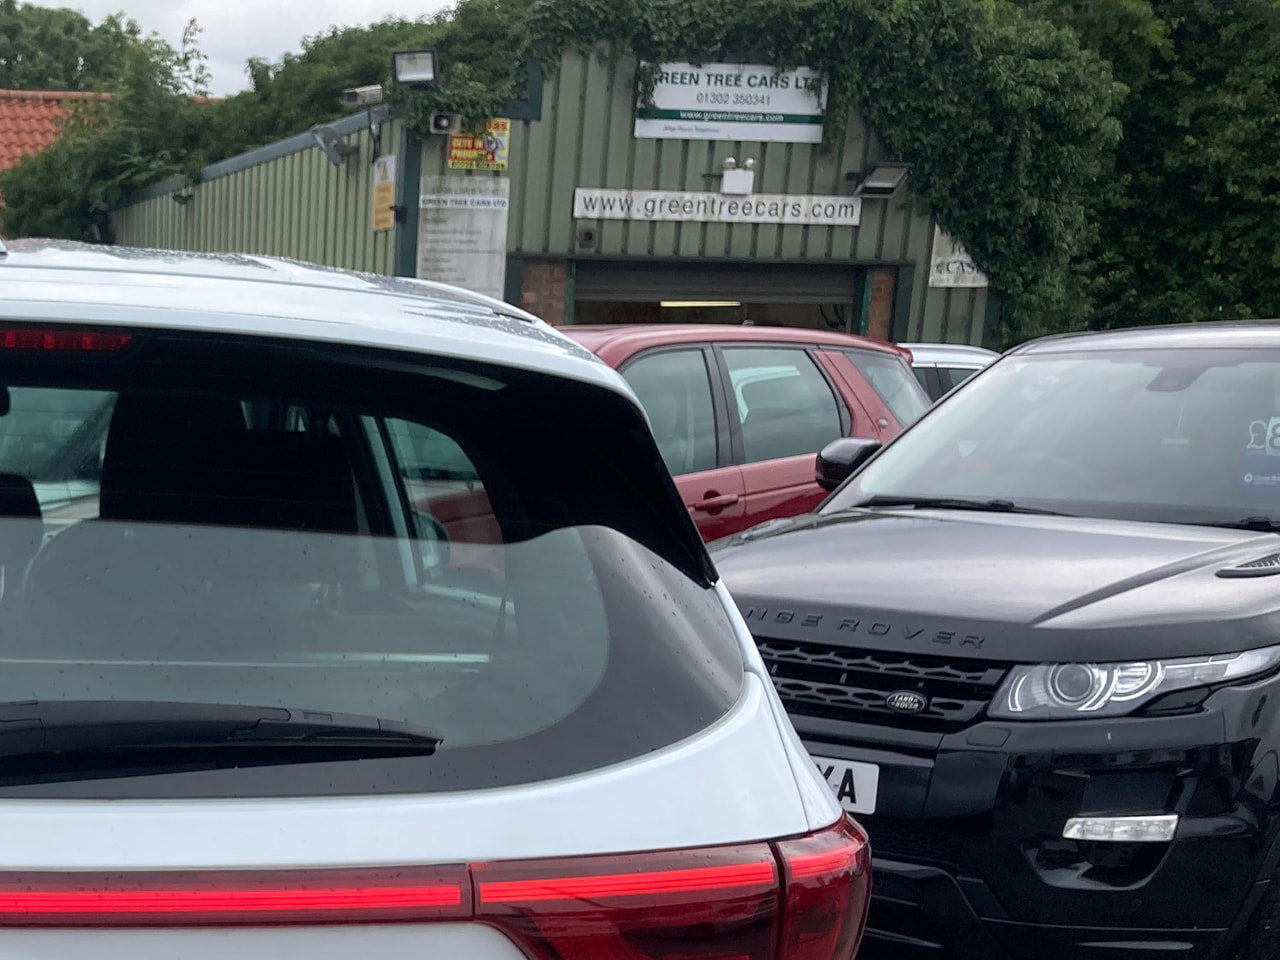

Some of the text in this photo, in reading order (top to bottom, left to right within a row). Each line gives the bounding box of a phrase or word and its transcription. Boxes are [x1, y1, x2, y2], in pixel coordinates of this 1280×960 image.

[705, 73, 743, 88] TREE
[747, 75, 790, 90] CARS
[582, 194, 855, 219] www.greentreecars.com
[747, 605, 986, 650] NGE ROVER
